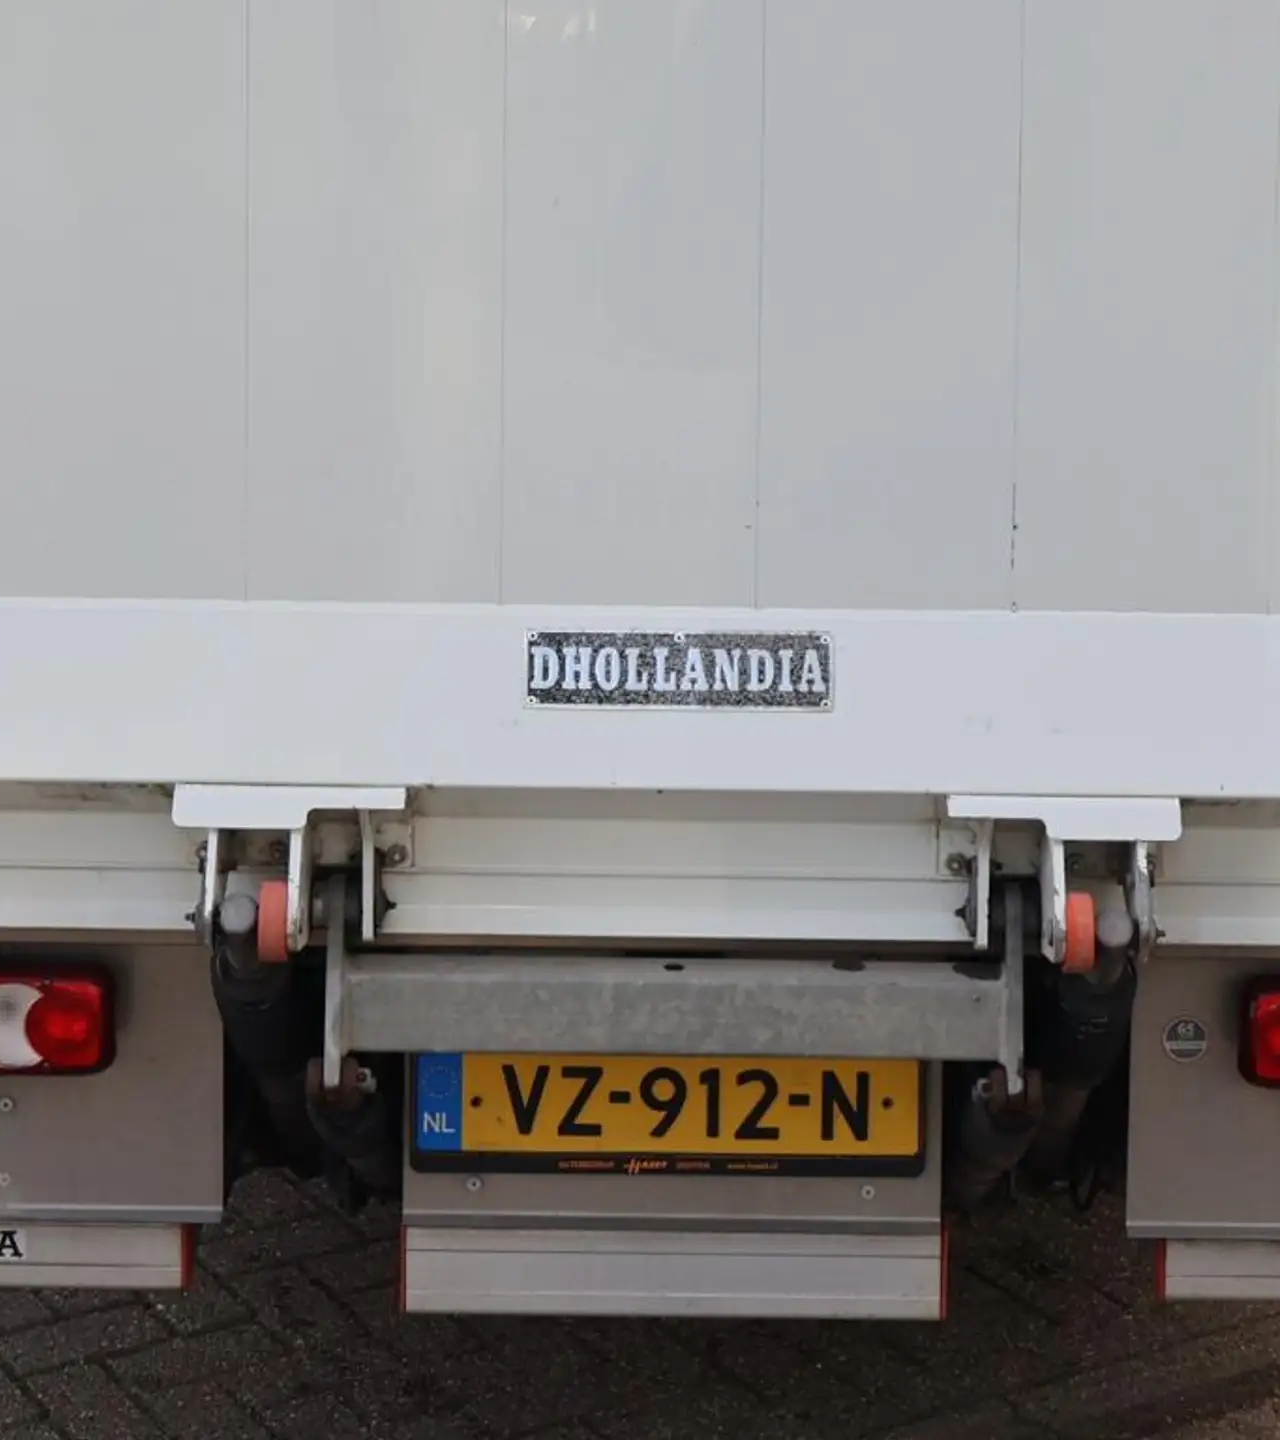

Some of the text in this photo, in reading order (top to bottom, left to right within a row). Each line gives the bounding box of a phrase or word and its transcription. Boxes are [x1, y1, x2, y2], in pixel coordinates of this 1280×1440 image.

[529, 645, 826, 693] DHOLLANDIA
[422, 1063, 870, 1142] NL VZ-912-N
